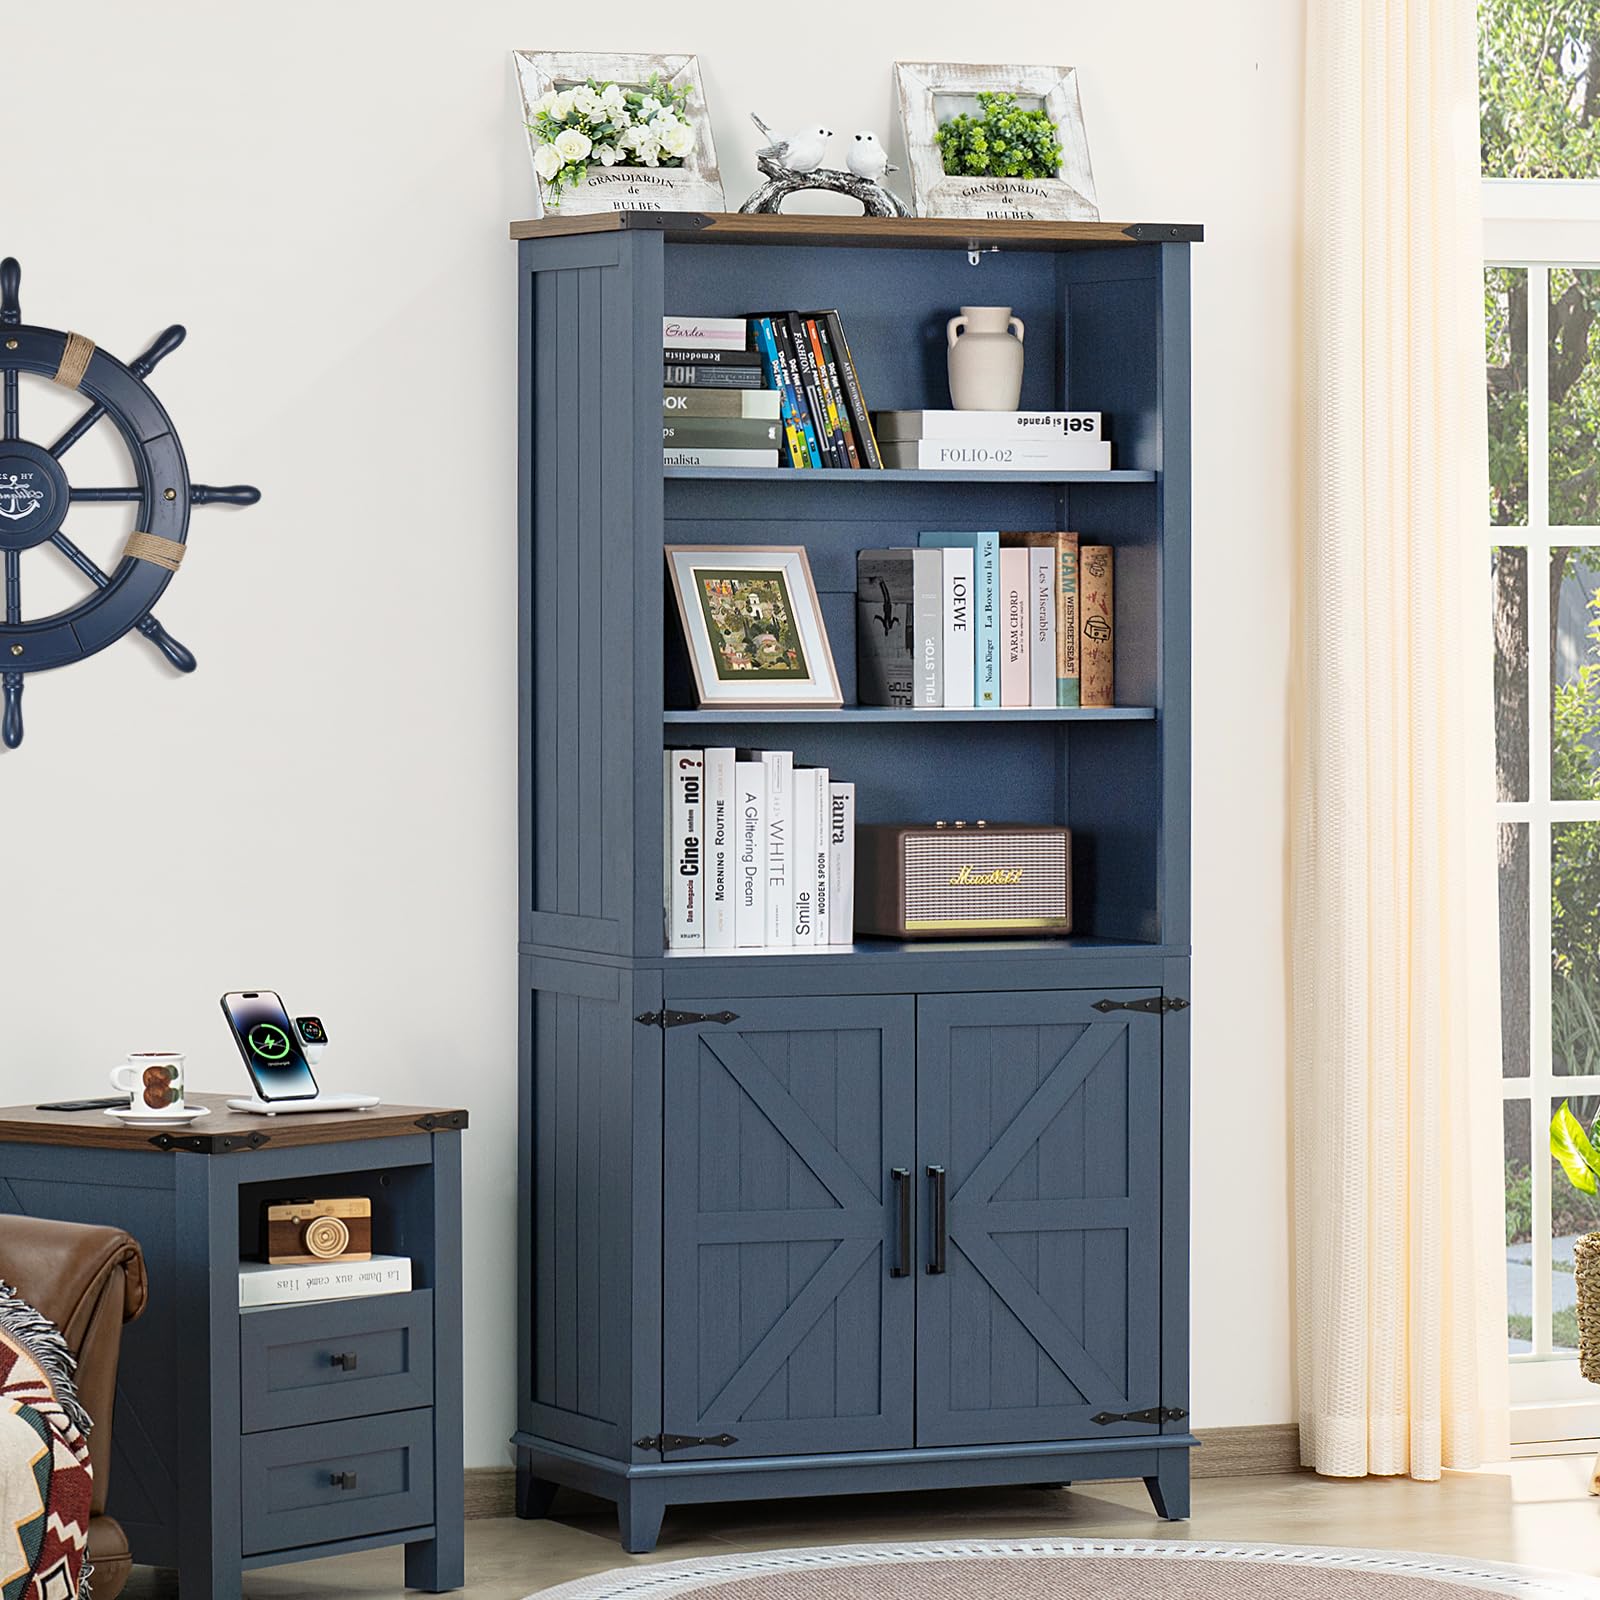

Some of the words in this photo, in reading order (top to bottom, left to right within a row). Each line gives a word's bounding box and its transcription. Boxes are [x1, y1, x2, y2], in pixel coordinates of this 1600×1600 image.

[588, 174, 674, 189] GRANDJARDIN
[627, 186, 640, 194] de
[962, 183, 1049, 198] GRANDJARDIN
[613, 201, 661, 210] BULBES
[1001, 195, 1014, 204] de
[986, 211, 1034, 220] BULBES
[665, 324, 705, 337] Garden
[665, 351, 721, 361] Remodelista
[793, 332, 811, 374] FASHION
[844, 362, 854, 380] ARTS
[663, 396, 688, 409] OK
[1017, 416, 1051, 425] grande
[1063, 418, 1094, 435] sei
[940, 449, 1013, 462] FOLIO-02
[984, 541, 993, 557] Vie
[984, 560, 993, 569] la
[1062, 552, 1076, 593] CAM
[988, 571, 993, 585] ou
[1040, 566, 1048, 584] Les
[954, 576, 966, 631] LOEWE
[985, 588, 993, 612] Boxe
[985, 615, 993, 628] La
[1040, 587, 1048, 642] Miserables
[925, 636, 936, 670] STOP.
[925, 672, 936, 703] FULL
[679, 758, 702, 770] ?
[680, 776, 700, 804] noi
[745, 792, 757, 803] A
[715, 800, 724, 846] ROUTINE
[742, 806, 759, 862] Glittering
[680, 837, 700, 876] Cine
[770, 820, 784, 886] WHITE
[818, 852, 826, 879] SPOON
[715, 852, 724, 901] MORNING
[745, 866, 758, 907] Dream
[818, 882, 826, 915] WOODEN
[796, 892, 810, 936] Smile
[336, 1274, 352, 1284] aux
[358, 1272, 382, 1283] Dame
[387, 1270, 400, 1281] La
